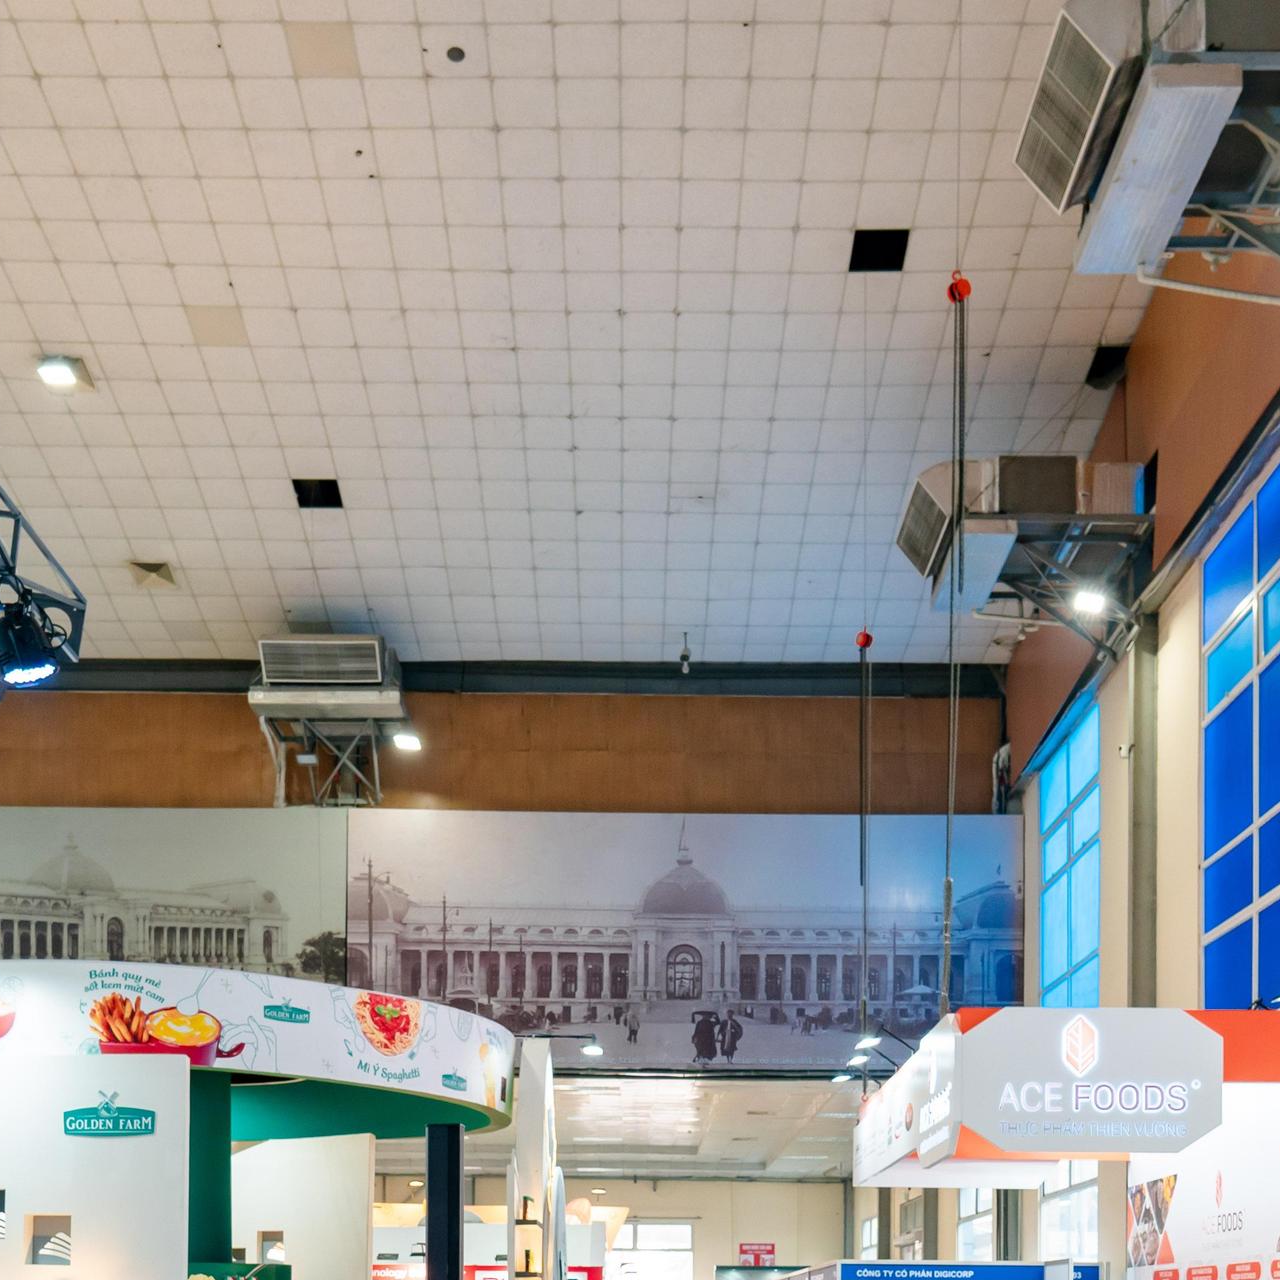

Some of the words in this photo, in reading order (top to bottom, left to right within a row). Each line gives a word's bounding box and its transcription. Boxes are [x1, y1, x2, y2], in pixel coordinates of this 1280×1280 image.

[89, 968, 119, 980] Bánh
[121, 971, 141, 985] quy
[101, 980, 121, 991] kem
[145, 990, 165, 1004] cam
[264, 1008, 290, 1018] GOLDEN
[291, 1012, 310, 1021] FARM
[381, 1067, 420, 1083] Spaghetti
[998, 1081, 1064, 1113] ACE
[1074, 1082, 1188, 1112] FOODS
[66, 1116, 113, 1130] GOLDEN
[119, 1116, 152, 1130] FARM
[1218, 1212, 1244, 1232] FOODS
[934, 1271, 974, 1279] DIGICORP
